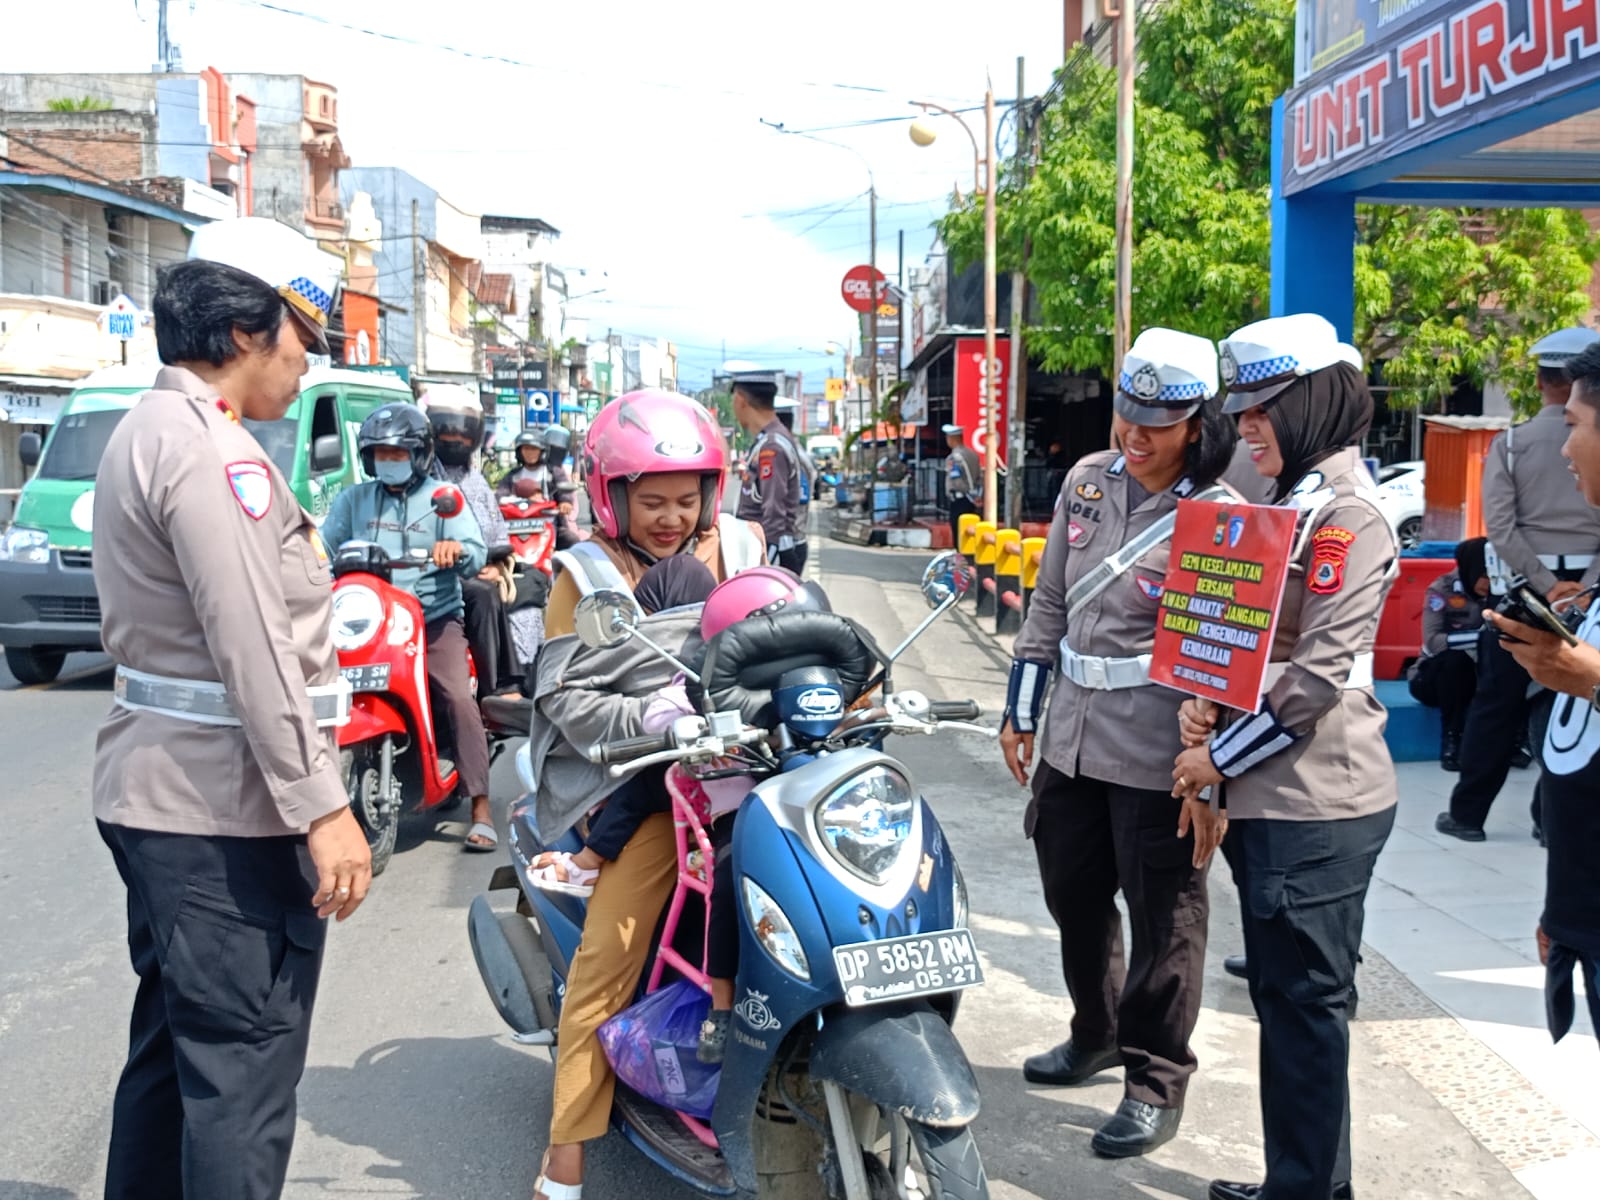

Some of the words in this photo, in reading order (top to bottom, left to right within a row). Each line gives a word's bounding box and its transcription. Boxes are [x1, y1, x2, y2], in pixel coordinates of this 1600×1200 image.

[1294, 52, 1391, 175] UNIT
[496, 370, 542, 380] SAMUNG
[1067, 500, 1101, 523] DEL
[1181, 554, 1200, 570] DEMI
[1201, 556, 1263, 582] KESELAMATAN
[1161, 591, 1189, 611] AWASI
[1163, 612, 1200, 635] BIARKAN
[838, 949, 869, 981] DP
[877, 940, 938, 974] 5852
[938, 935, 974, 966] RM
